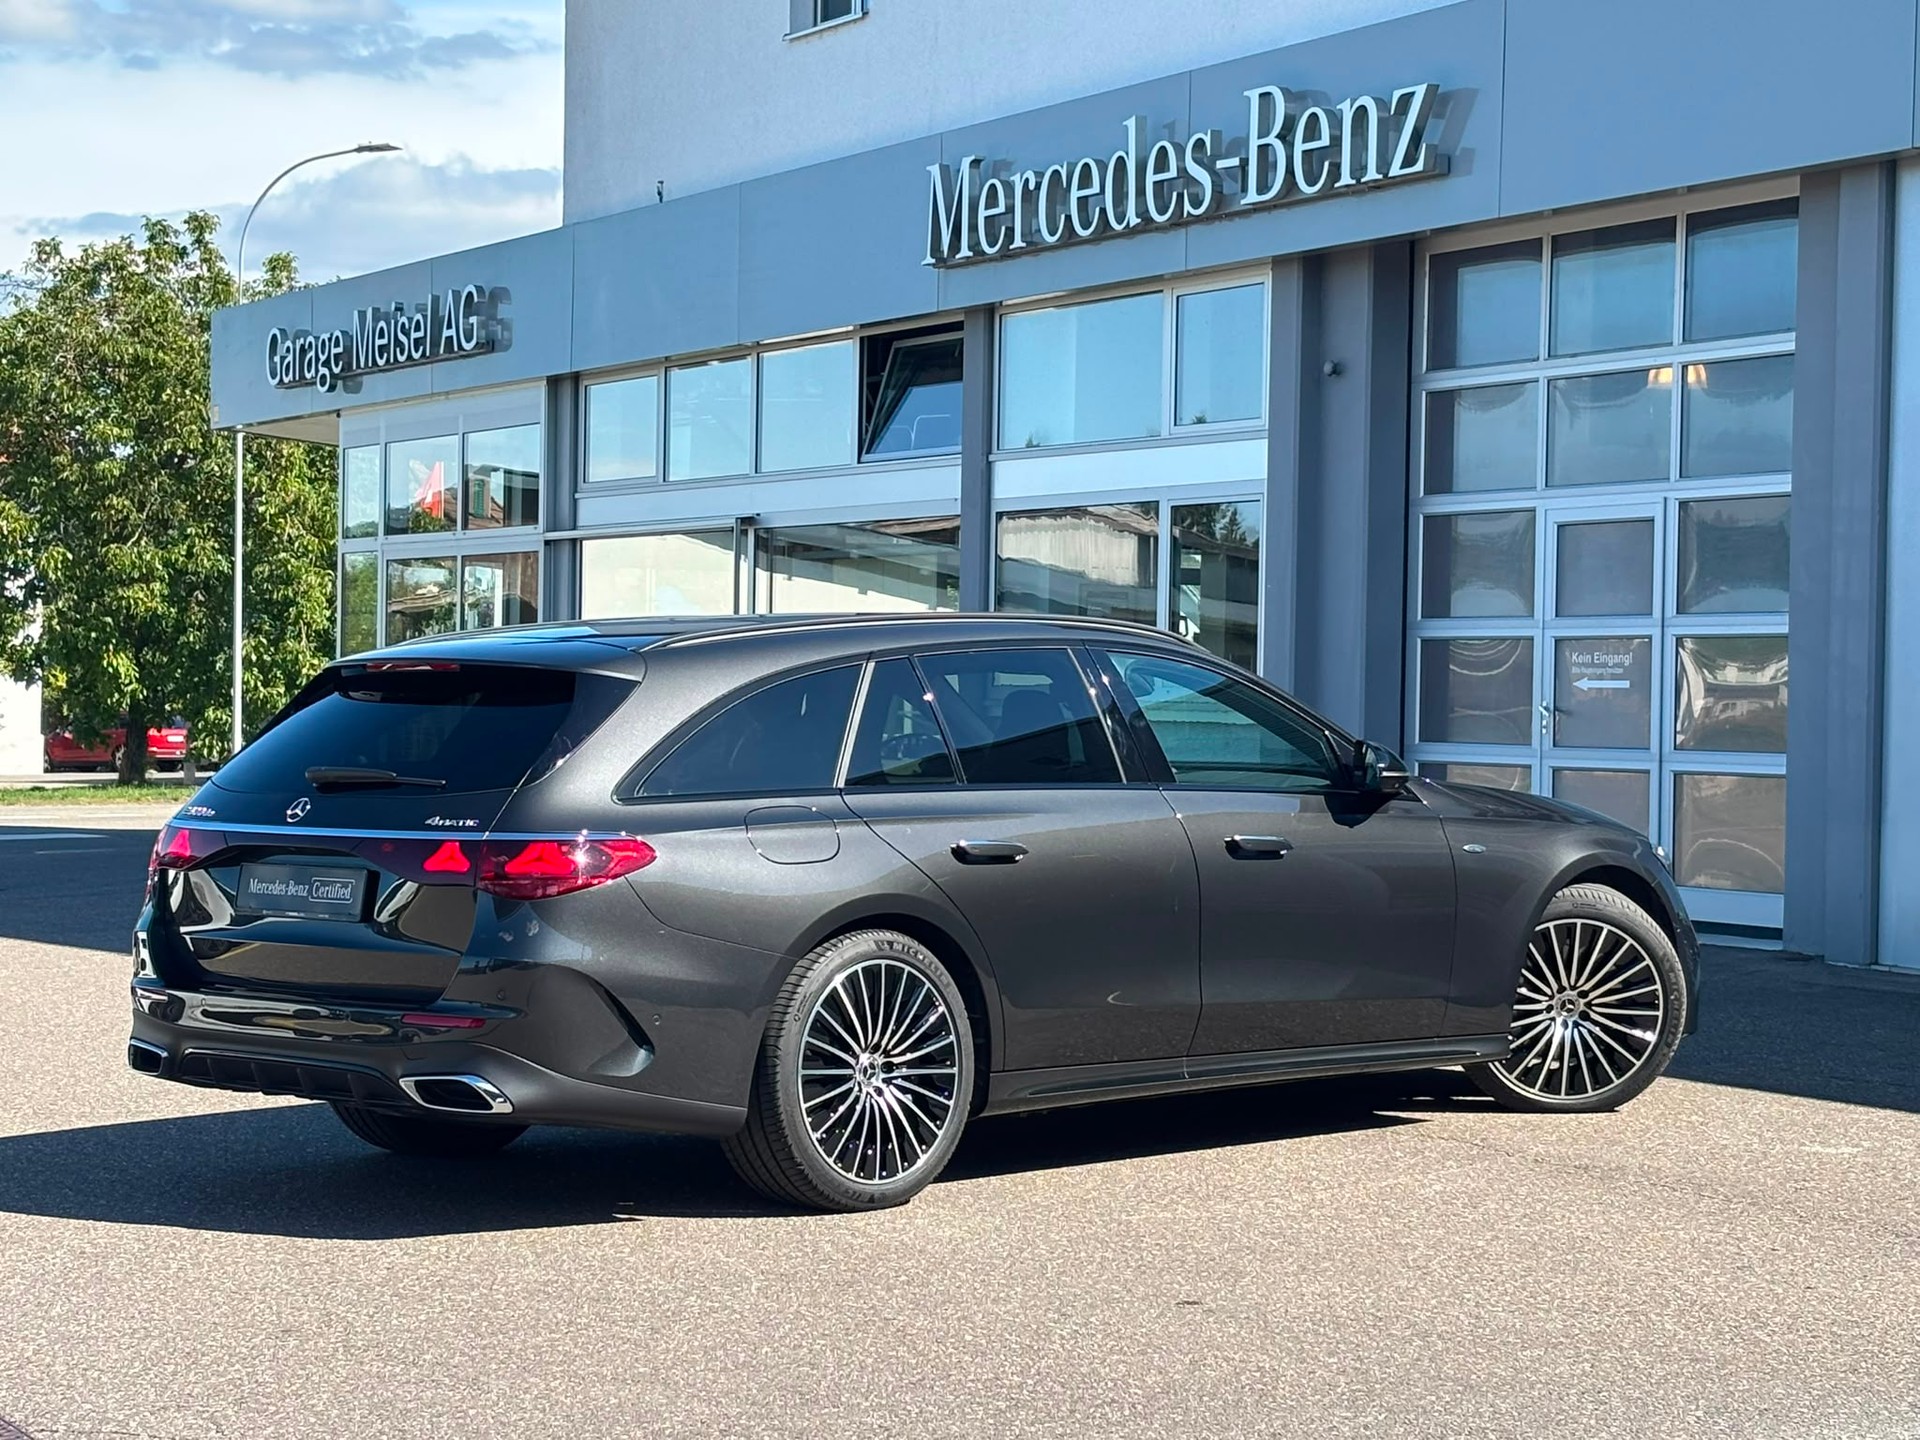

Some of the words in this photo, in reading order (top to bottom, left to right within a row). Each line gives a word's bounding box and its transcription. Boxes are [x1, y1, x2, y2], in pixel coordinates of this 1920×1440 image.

[921, 83, 1440, 267] Mercedes-Benz
[266, 327, 343, 393] Garage
[352, 293, 434, 370] Meisel
[440, 284, 479, 354] AG
[1572, 652, 1592, 663] Kein
[1594, 652, 1633, 666] Eingang!
[248, 878, 309, 897] Mercedes-Benz
[312, 881, 352, 899] Certified
